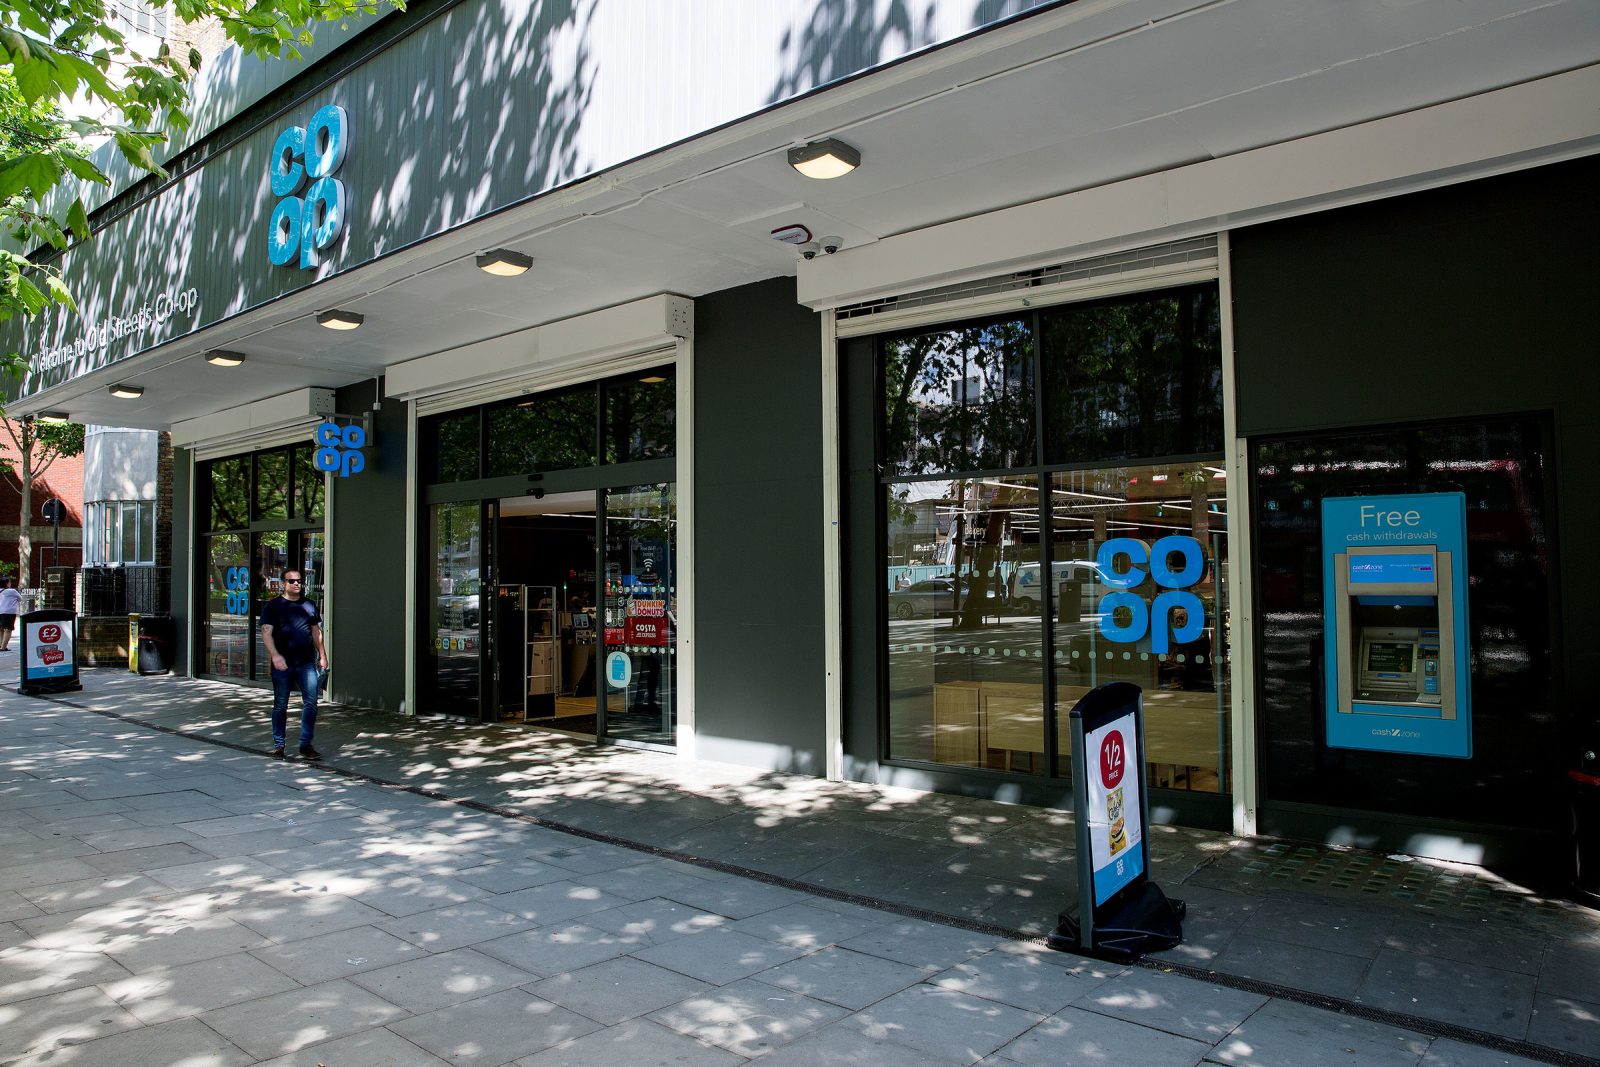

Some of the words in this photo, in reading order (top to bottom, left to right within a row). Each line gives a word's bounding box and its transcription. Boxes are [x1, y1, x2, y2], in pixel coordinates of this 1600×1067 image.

[74, 337, 85, 357] to
[87, 319, 107, 352] Old
[155, 287, 198, 323] Co-op
[1360, 505, 1421, 528] Free
[1346, 531, 1370, 541] cash
[1373, 530, 1438, 541] withdrawals
[637, 608, 664, 616] DONUTS
[42, 628, 58, 638] £2
[635, 624, 656, 633] COSTA
[1108, 771, 1119, 781] PRICE
